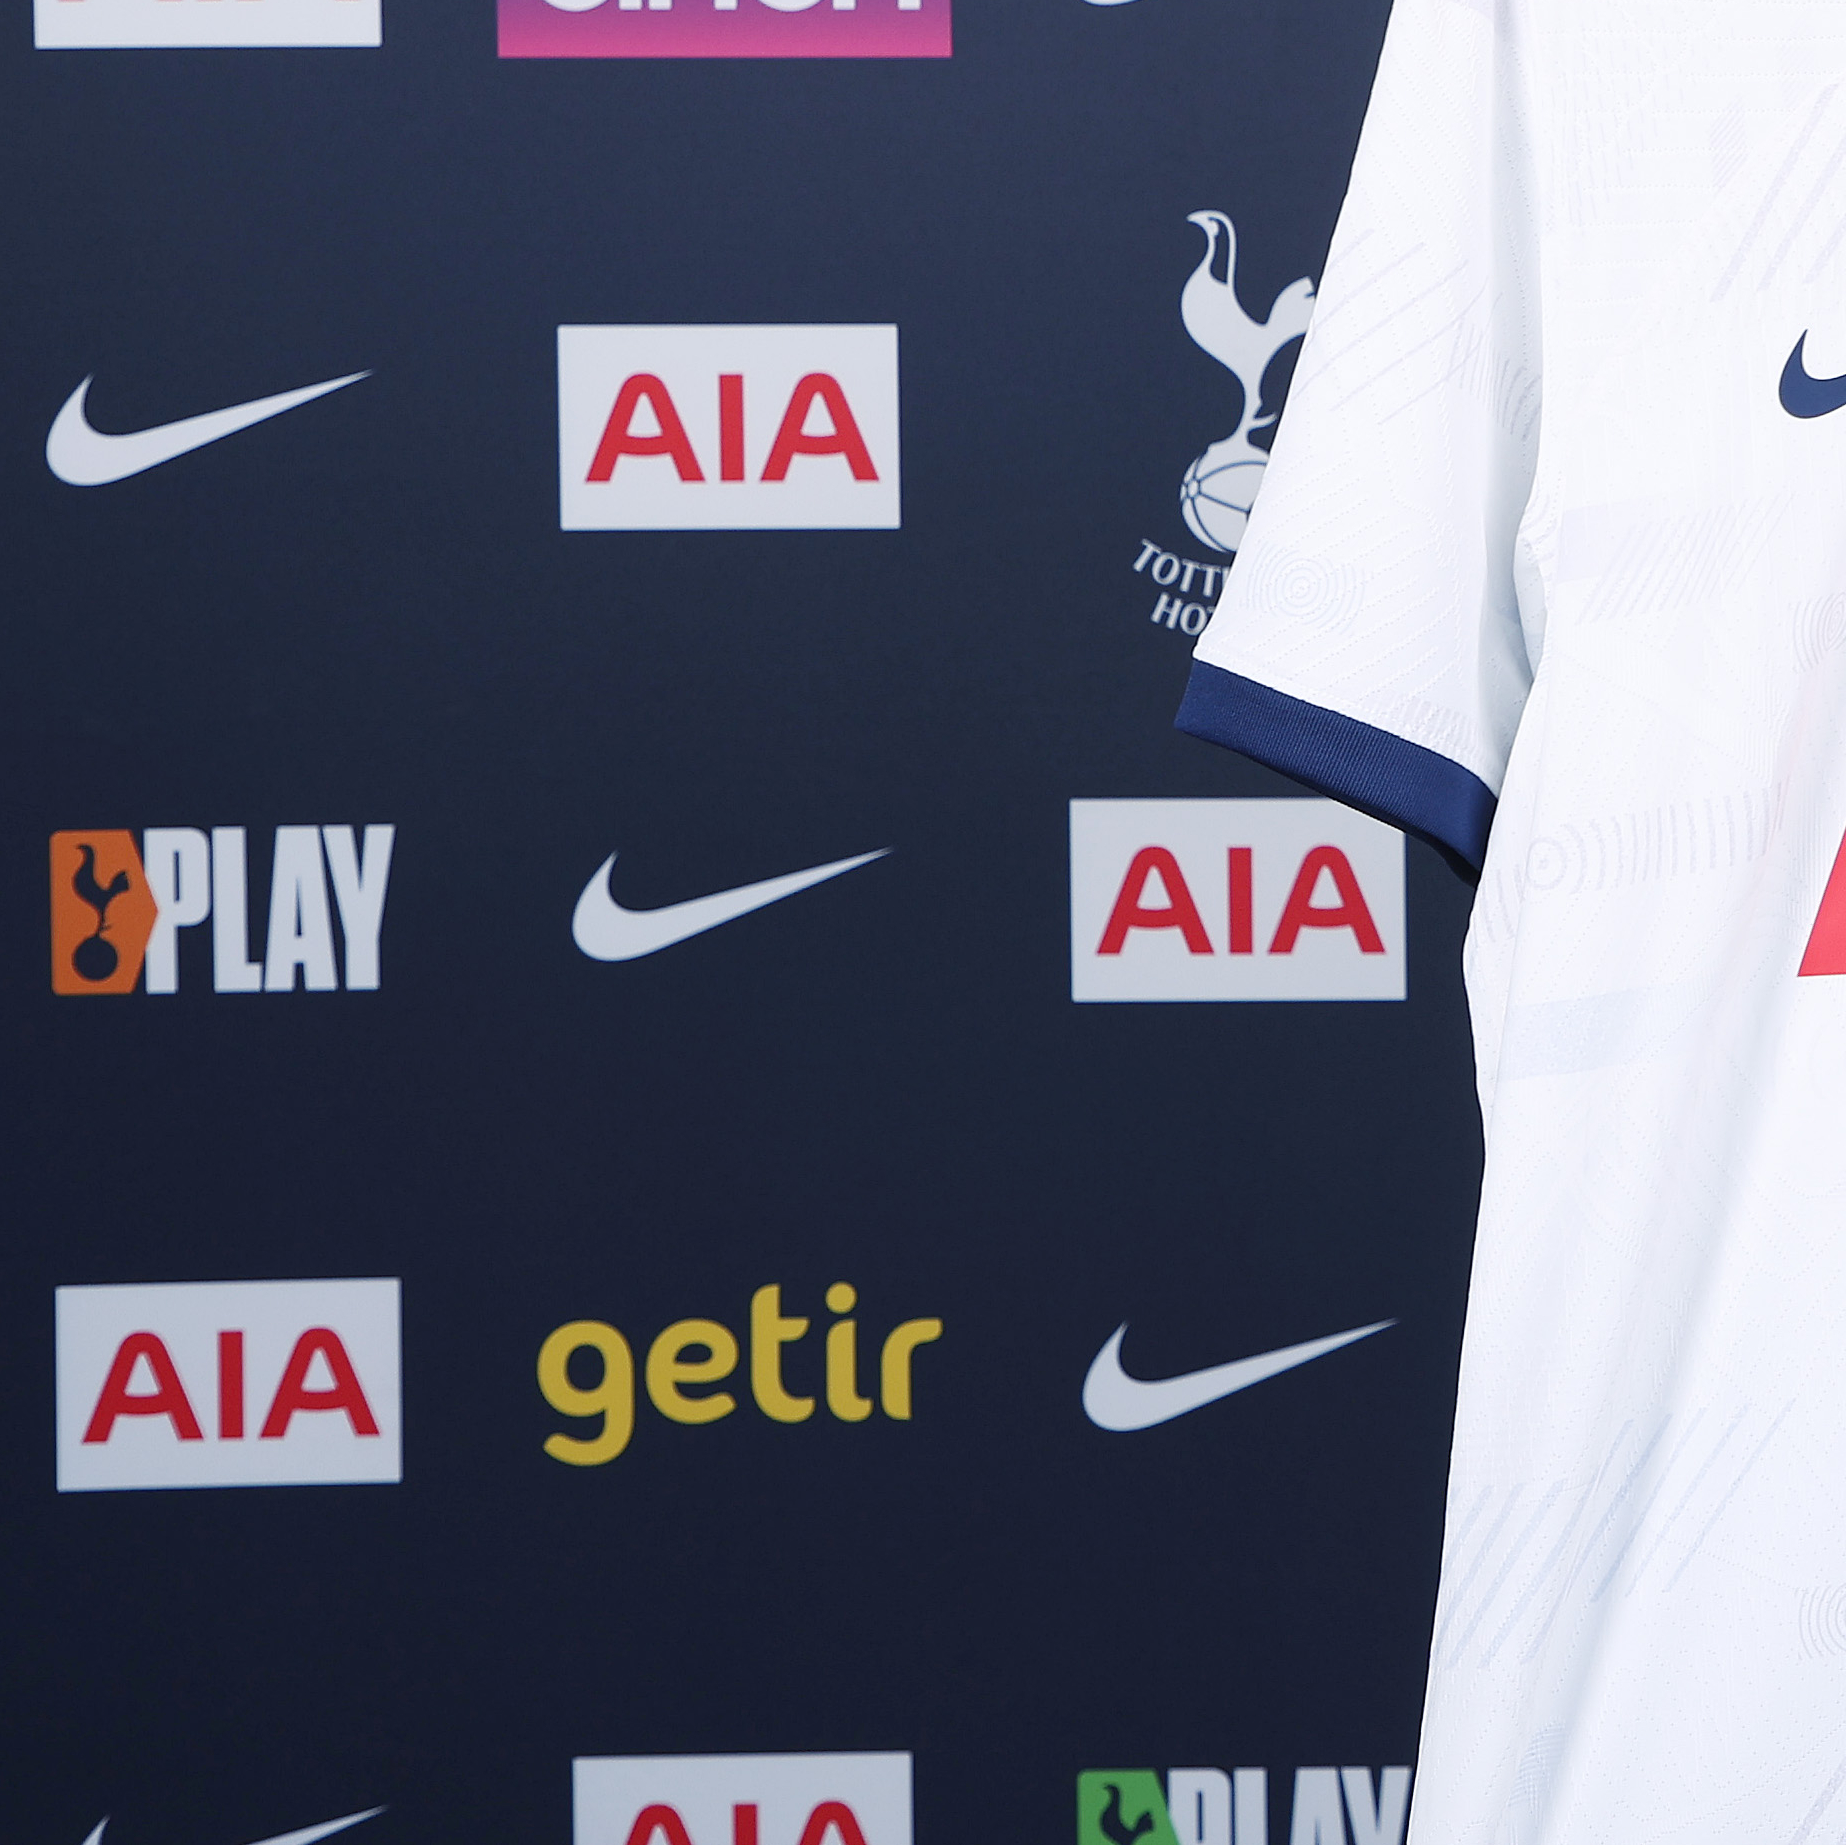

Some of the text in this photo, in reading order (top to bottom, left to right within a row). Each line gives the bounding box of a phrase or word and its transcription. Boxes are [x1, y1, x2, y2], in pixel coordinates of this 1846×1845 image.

[586, 373, 879, 483] AIA
[143, 824, 395, 994] PLAY
[1097, 845, 1385, 955] AIA
[83, 1328, 379, 1443] AIA
[537, 1282, 943, 1466] getir
